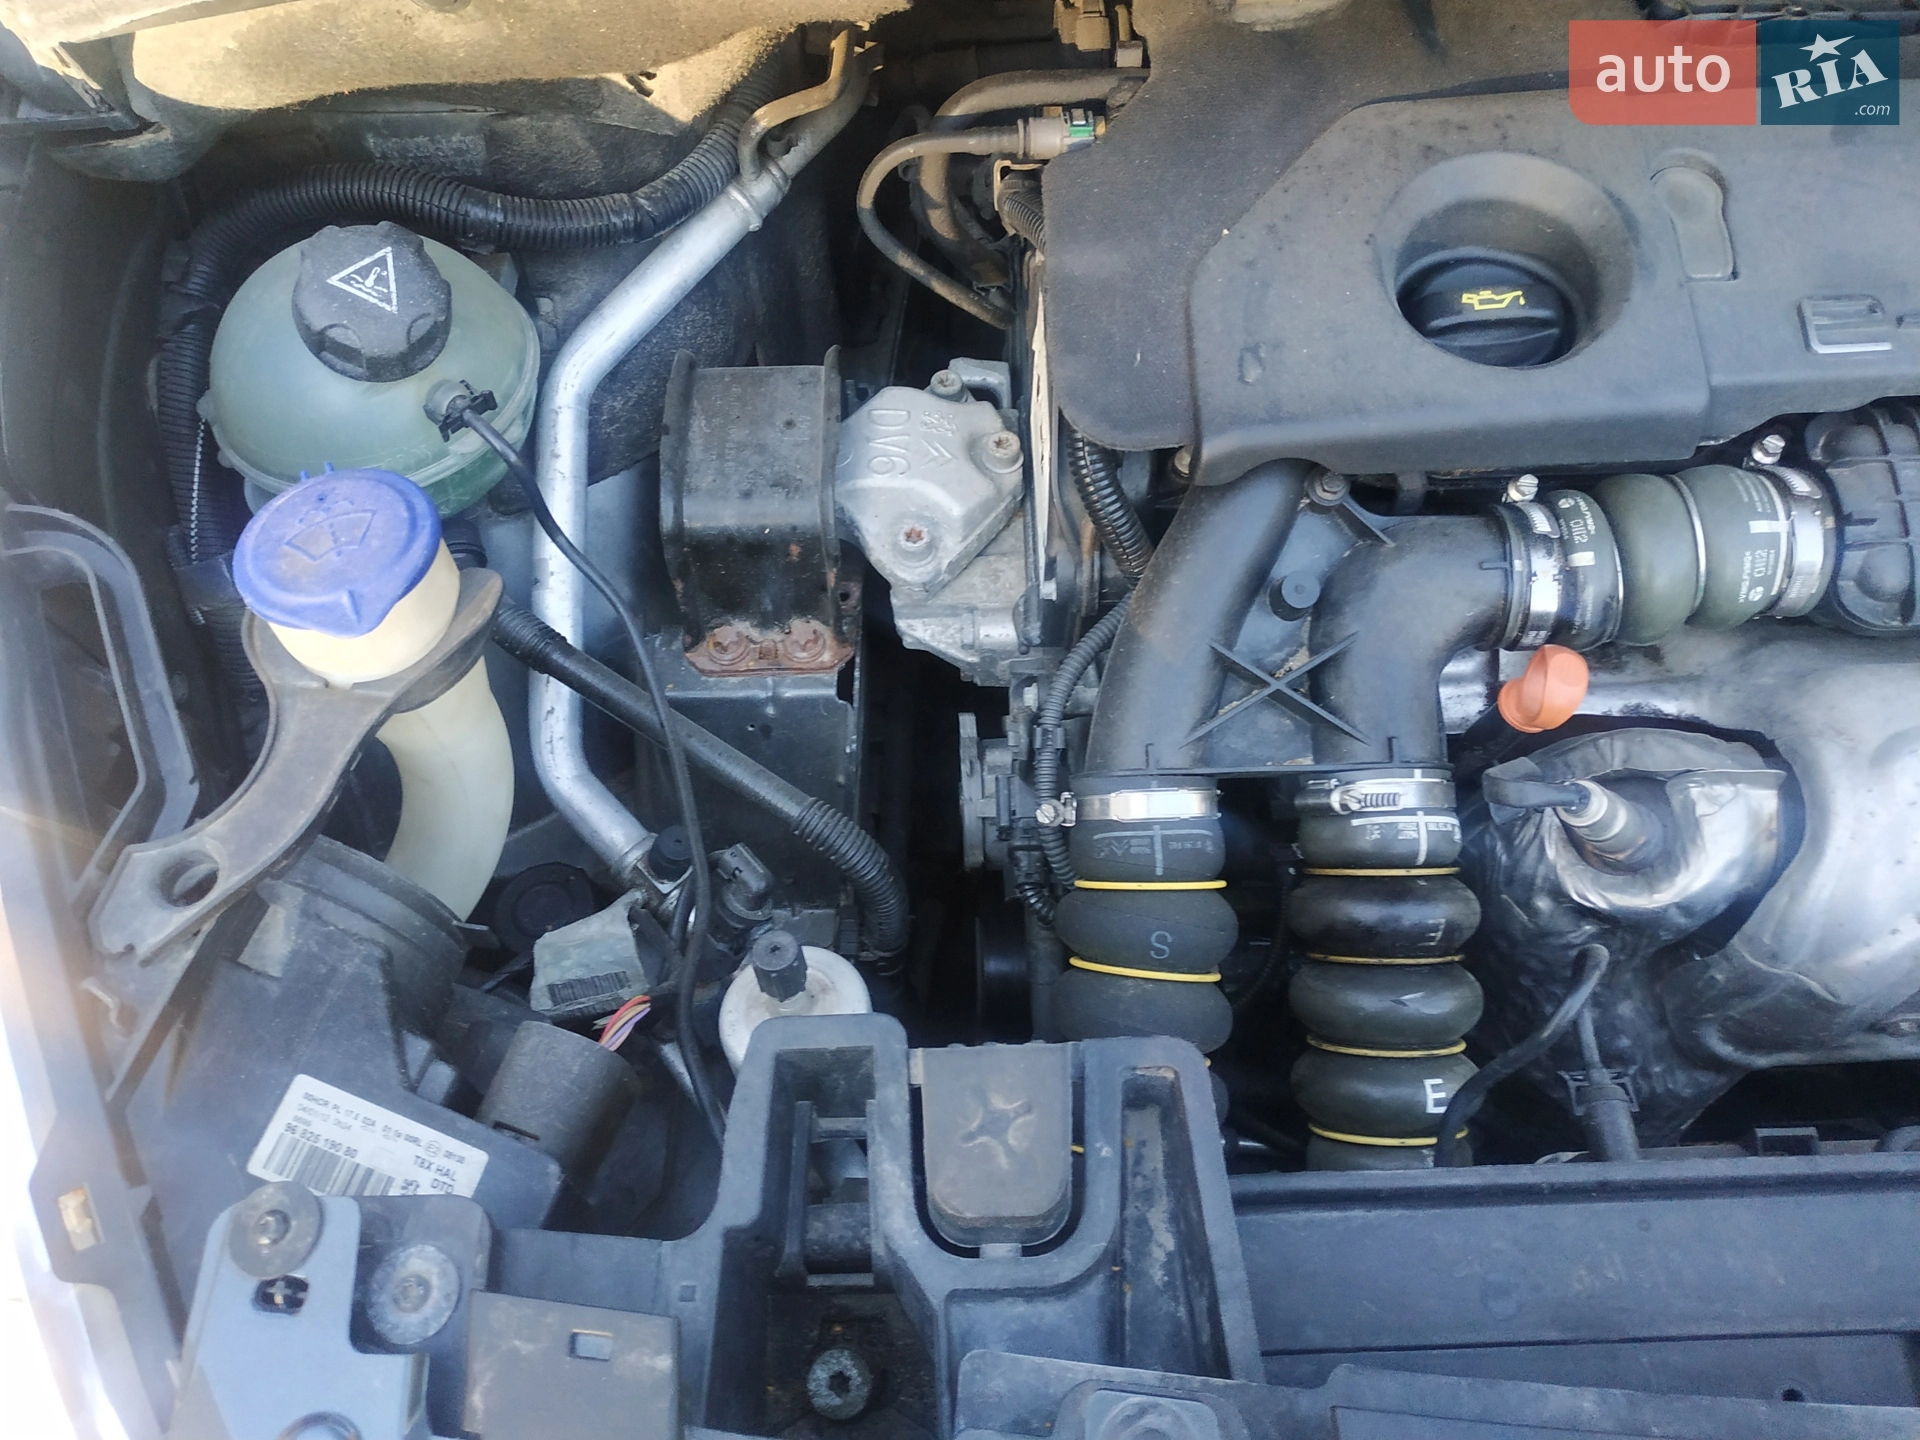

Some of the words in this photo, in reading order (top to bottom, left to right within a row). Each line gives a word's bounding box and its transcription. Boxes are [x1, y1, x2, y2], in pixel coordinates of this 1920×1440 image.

[867, 408, 912, 477] DV6
[1149, 930, 1173, 960] S
[1422, 1078, 1448, 1114] E
[284, 1123, 298, 1135] 96
[435, 1165, 457, 1182] HAL
